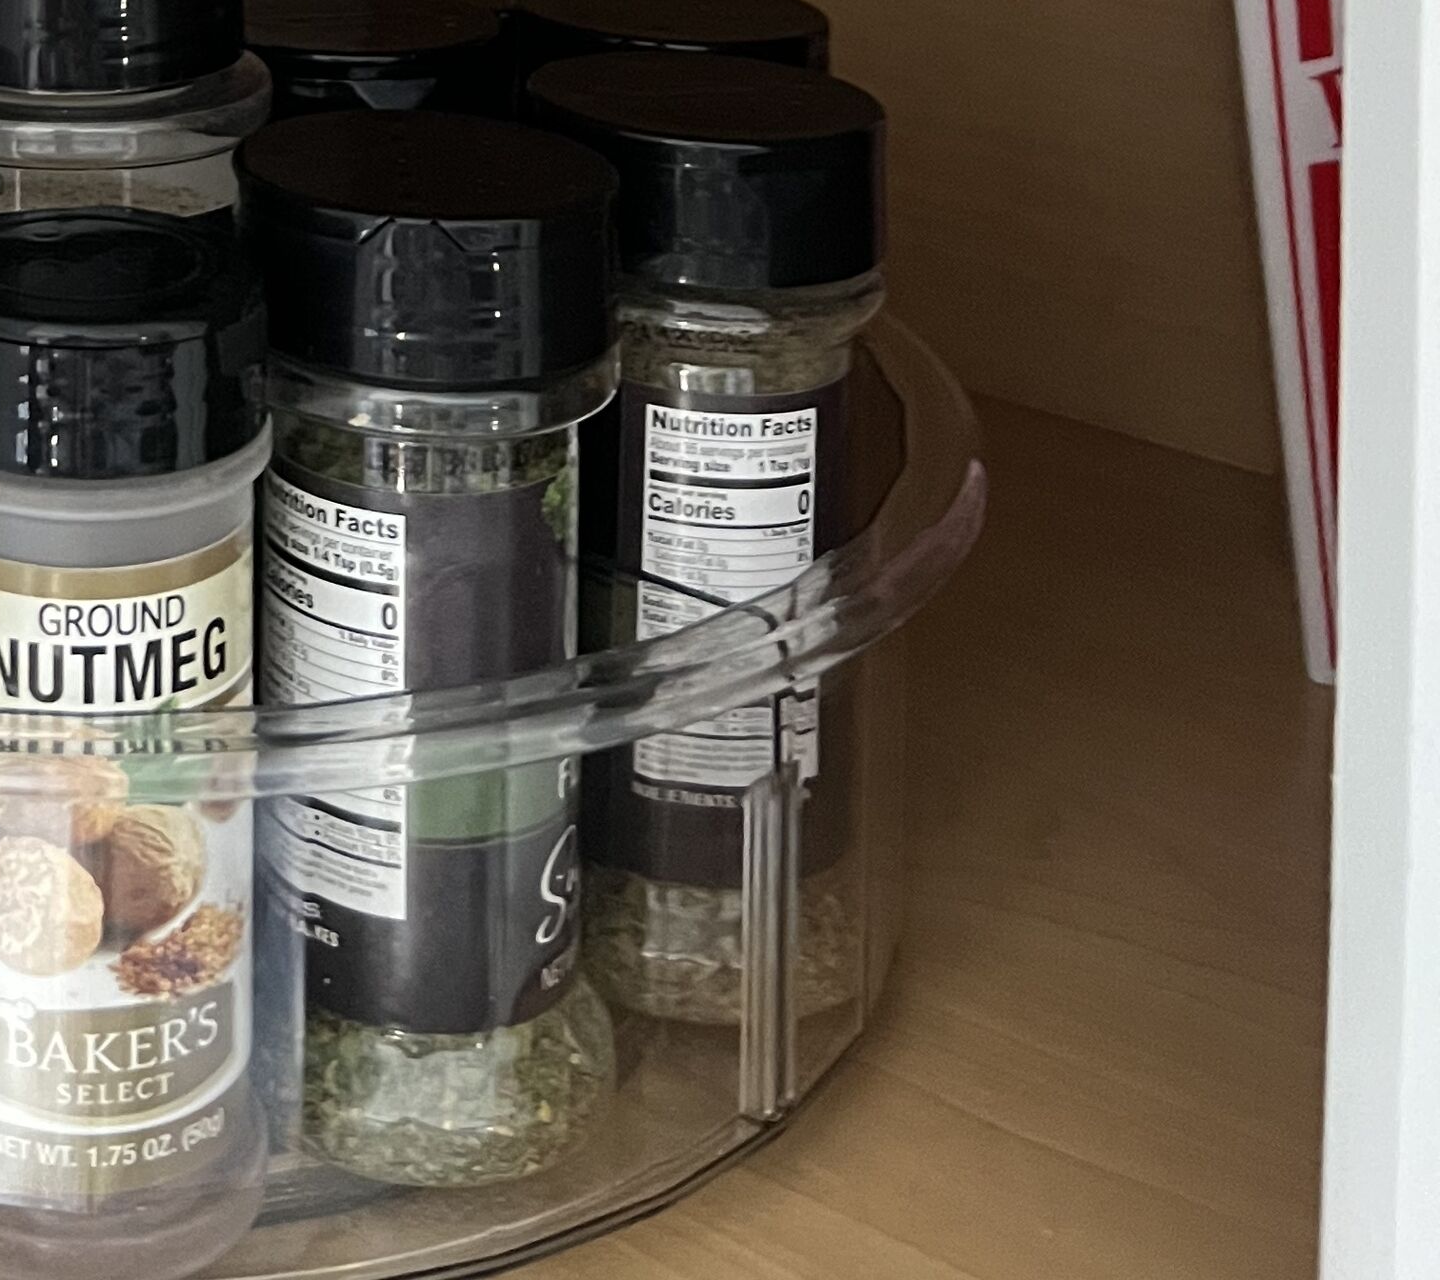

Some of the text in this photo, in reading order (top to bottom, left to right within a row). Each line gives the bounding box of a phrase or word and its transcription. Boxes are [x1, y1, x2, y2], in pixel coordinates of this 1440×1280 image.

[651, 409, 813, 438] Nutrition Facts
[648, 492, 736, 521] Calories
[797, 489, 810, 516] 0
[334, 508, 399, 540] Facts
[37, 594, 186, 638] GROUND
[381, 601, 398, 630] 0
[4, 1001, 219, 1075] BAKER'S
[56, 1071, 175, 1106] SELECT
[86, 1142, 138, 1168] 1.75
[141, 1133, 178, 1161] OZ.
